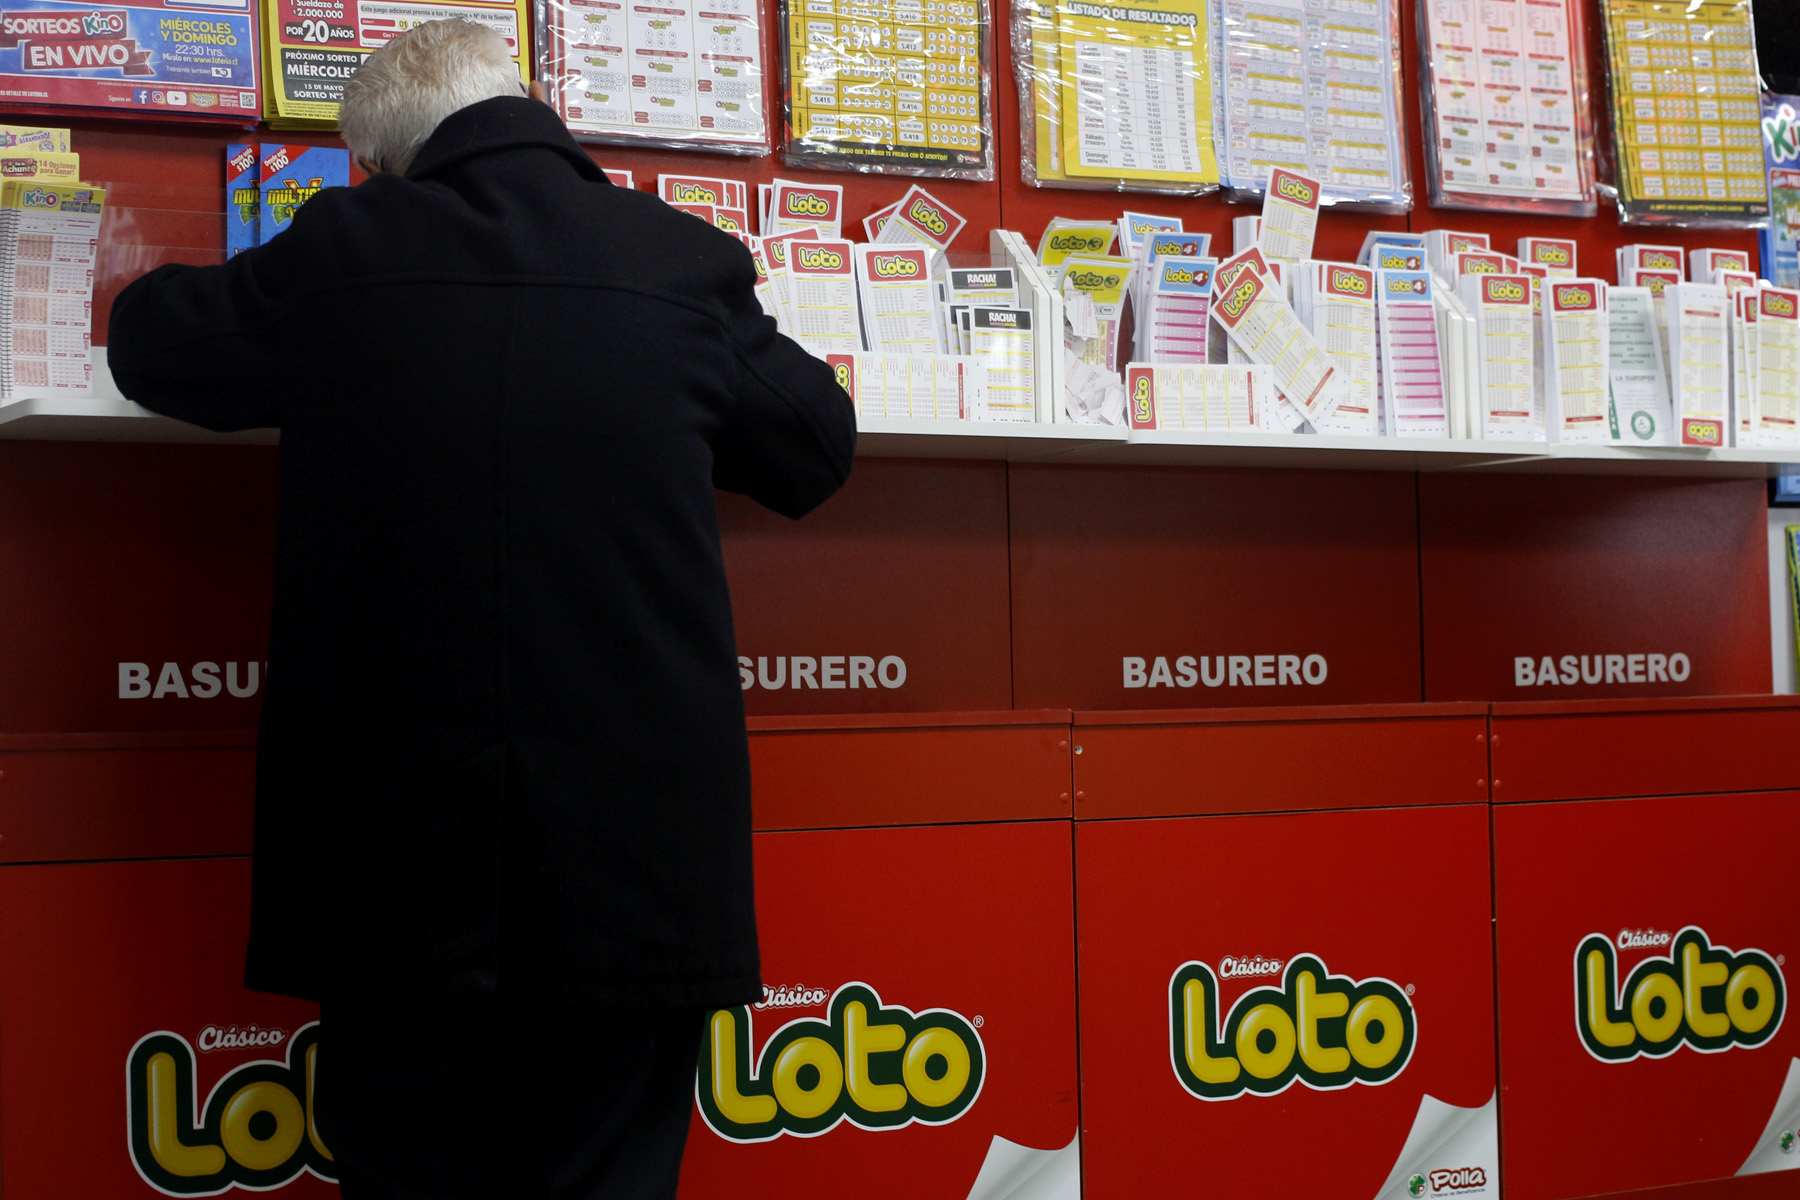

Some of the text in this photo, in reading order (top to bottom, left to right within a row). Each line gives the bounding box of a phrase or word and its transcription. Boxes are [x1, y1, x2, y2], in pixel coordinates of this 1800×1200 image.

[293, 8, 344, 19] $2.000.000
[297, 0, 332, 8] Sueldazo
[1068, 2, 1110, 18] LISTADO
[1112, 8, 1126, 20] DE
[1128, 10, 1196, 26] RESULTADOS
[4, 18, 81, 34] SORTEOS
[160, 17, 231, 34] MIÉRCOLES
[286, 19, 355, 43] POR 20 AÑOS
[161, 30, 237, 46] Y DOMINGO
[30, 44, 129, 66] EN VIVO
[175, 44, 225, 57] 22:30 hrs.
[285, 51, 358, 63] PRÓXIMO SORTEO
[294, 91, 327, 99] SORTEO
[49, 161, 76, 169] Opciones
[236, 154, 255, 172] $100
[270, 155, 289, 172] $100
[234, 189, 260, 205] MUL
[267, 188, 321, 205] MULTI
[674, 183, 716, 203] Loto
[1280, 175, 1312, 202] Loto
[788, 193, 829, 215] Loto
[911, 199, 947, 234] Loto
[1050, 236, 1104, 251] Loto 3
[1155, 241, 1181, 255] Loto
[800, 247, 842, 269] Loto
[1381, 255, 1406, 269] Loto
[1537, 246, 1569, 264] Loto
[875, 255, 918, 276] Loto
[967, 273, 997, 284] RACHA!
[1069, 271, 1120, 288] Loto 3
[1165, 268, 1192, 283] Loto
[1333, 271, 1367, 293] Loto
[1387, 278, 1412, 292] Loto
[1224, 281, 1255, 316] Loto
[1489, 281, 1524, 299] Loto
[1559, 289, 1591, 307] Loto
[1764, 293, 1793, 312] Loto
[988, 312, 1016, 322] RACHA!
[1134, 376, 1151, 422] Loto
[1688, 423, 1719, 442] Loto
[737, 655, 907, 690] SURERO
[1122, 654, 1328, 688] BASURERO
[1514, 652, 1690, 687] BASURERO
[118, 661, 268, 699] BASU
[1617, 930, 1671, 949] Clásico
[1219, 956, 1282, 978] Clásico
[761, 985, 828, 1008] Clásico
[1581, 935, 1781, 1054] Loto
[1178, 964, 1410, 1091] Loto
[199, 1026, 287, 1050] Clásico
[705, 994, 977, 1131] Loto
[138, 1038, 335, 1186] Lo
[1430, 1167, 1487, 1191] Polla
